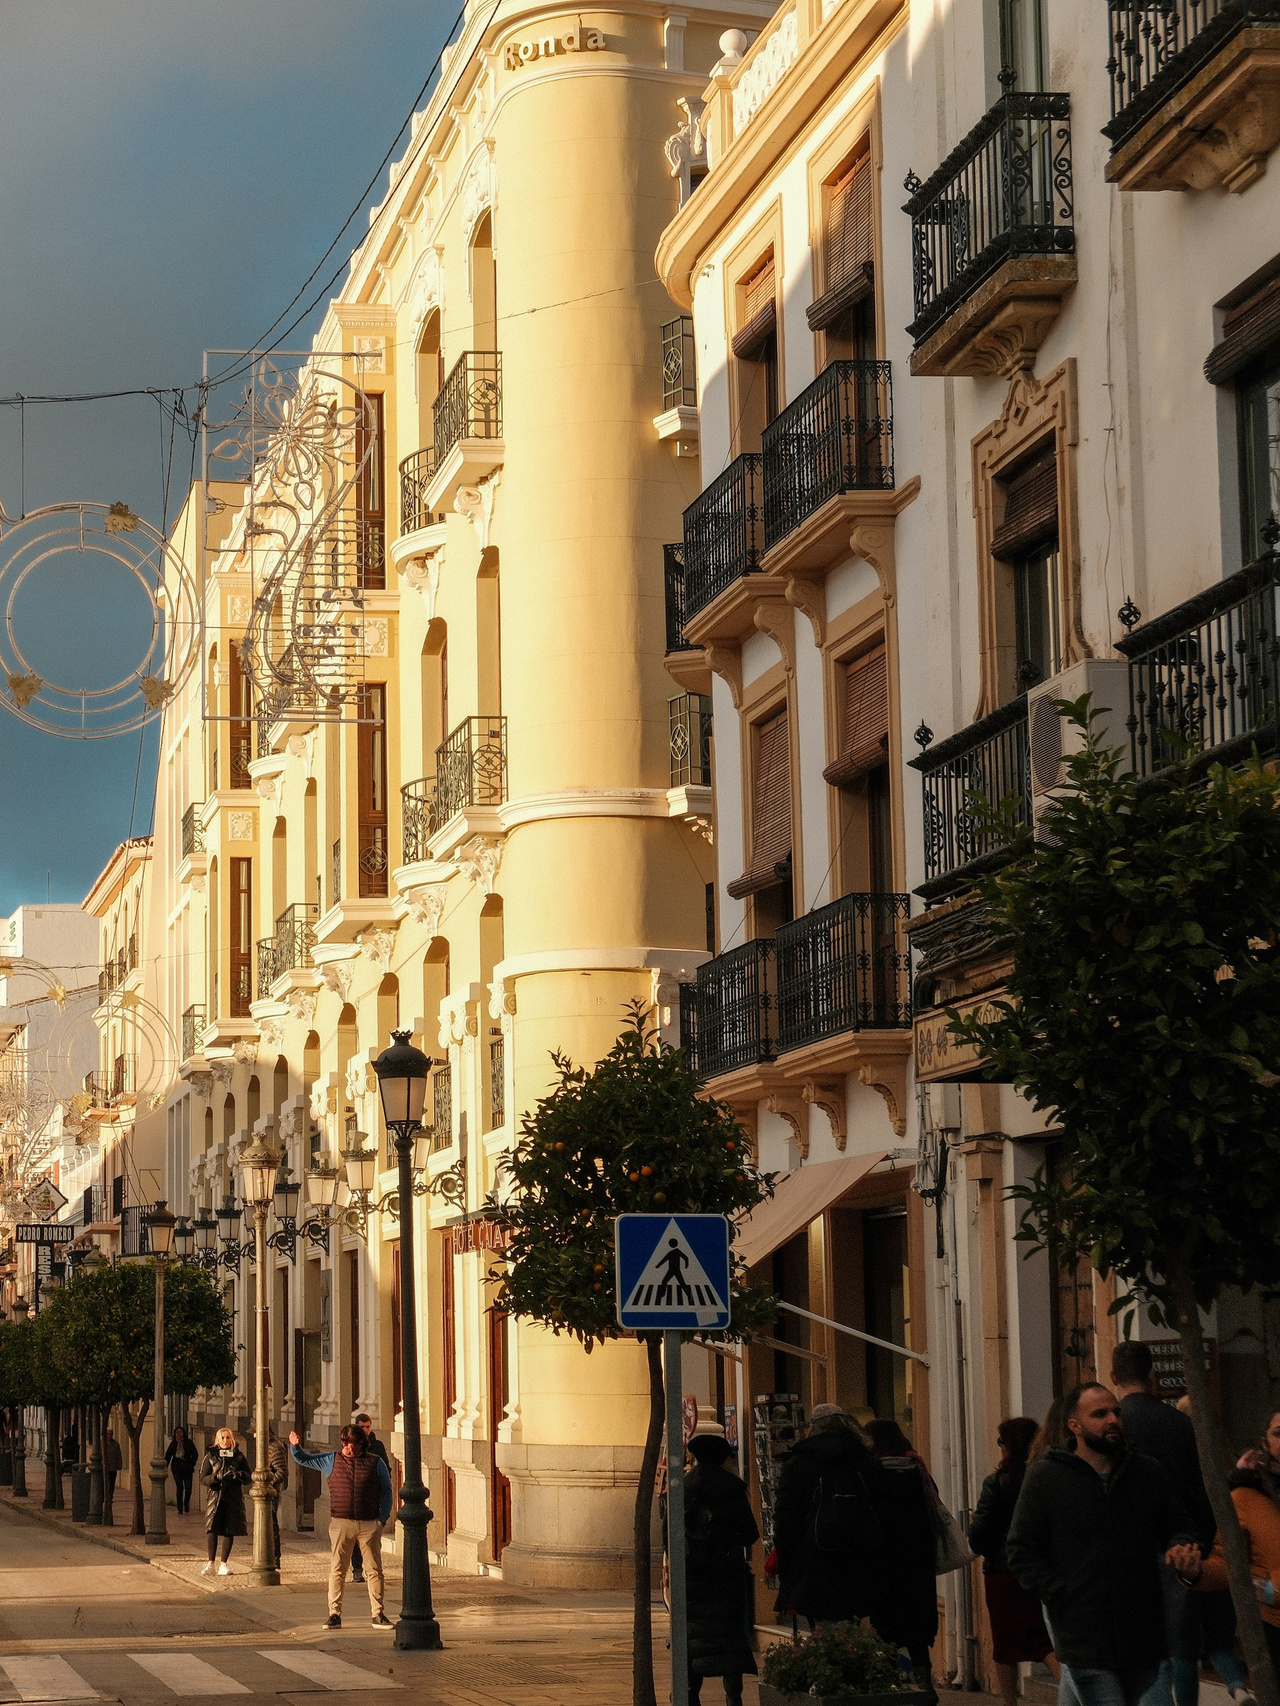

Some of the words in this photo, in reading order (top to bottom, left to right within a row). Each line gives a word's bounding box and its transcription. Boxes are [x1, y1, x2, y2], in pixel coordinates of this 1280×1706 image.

[503, 24, 606, 71] Ronda
[18, 1226, 40, 1241] PEDRO
[43, 1226, 72, 1241] ROMERO
[452, 1221, 476, 1255] HOTEL
